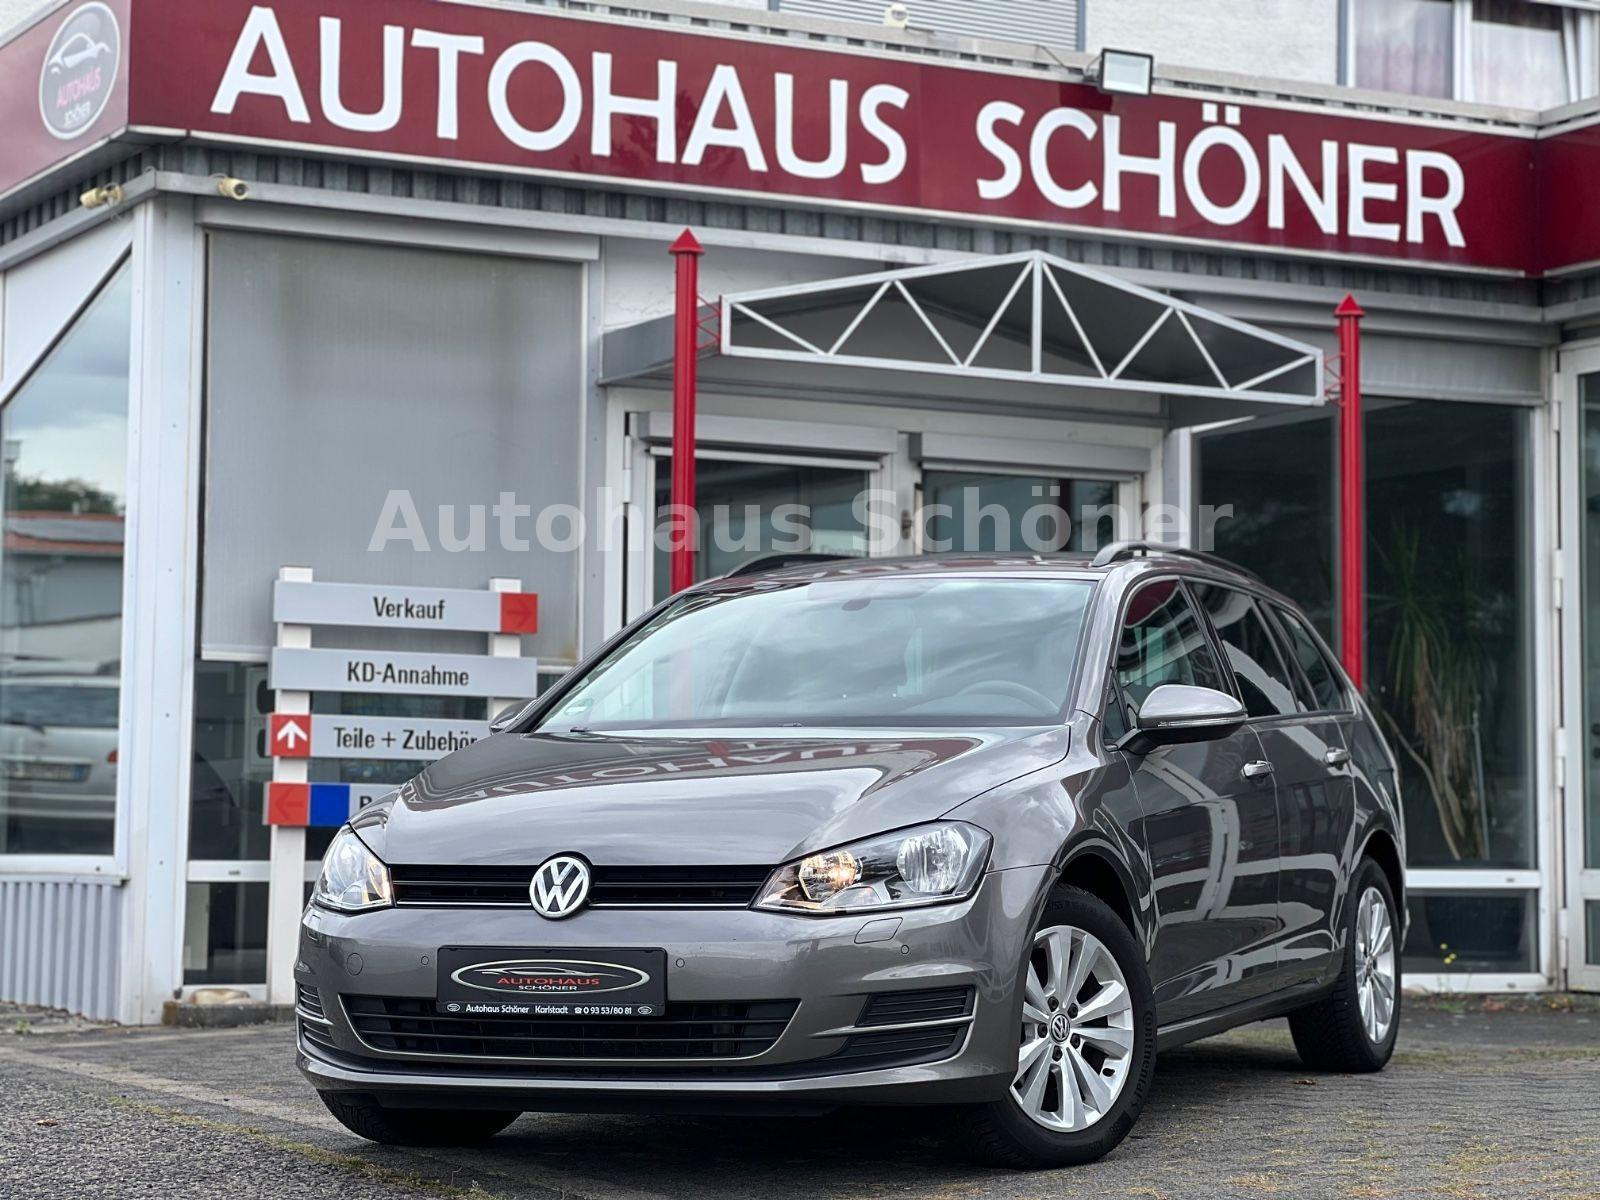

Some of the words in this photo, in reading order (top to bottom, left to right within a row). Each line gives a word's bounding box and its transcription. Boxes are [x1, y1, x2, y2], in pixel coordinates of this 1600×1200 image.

[56, 66, 102, 109] AUTOHAUS
[211, 6, 908, 184] AUTOHAUS
[976, 101, 1466, 247] SCHÖNER
[373, 597, 446, 620] Verkauf
[347, 661, 470, 686] KD-Annahme
[333, 727, 375, 748] Teile
[381, 731, 397, 748] +
[529, 857, 590, 918] VW
[497, 977, 600, 985] AUTOHAUS
[465, 1004, 500, 1013] Autohaus
[501, 1005, 529, 1014] Schöner
[535, 1005, 568, 1014] Karlstadt
